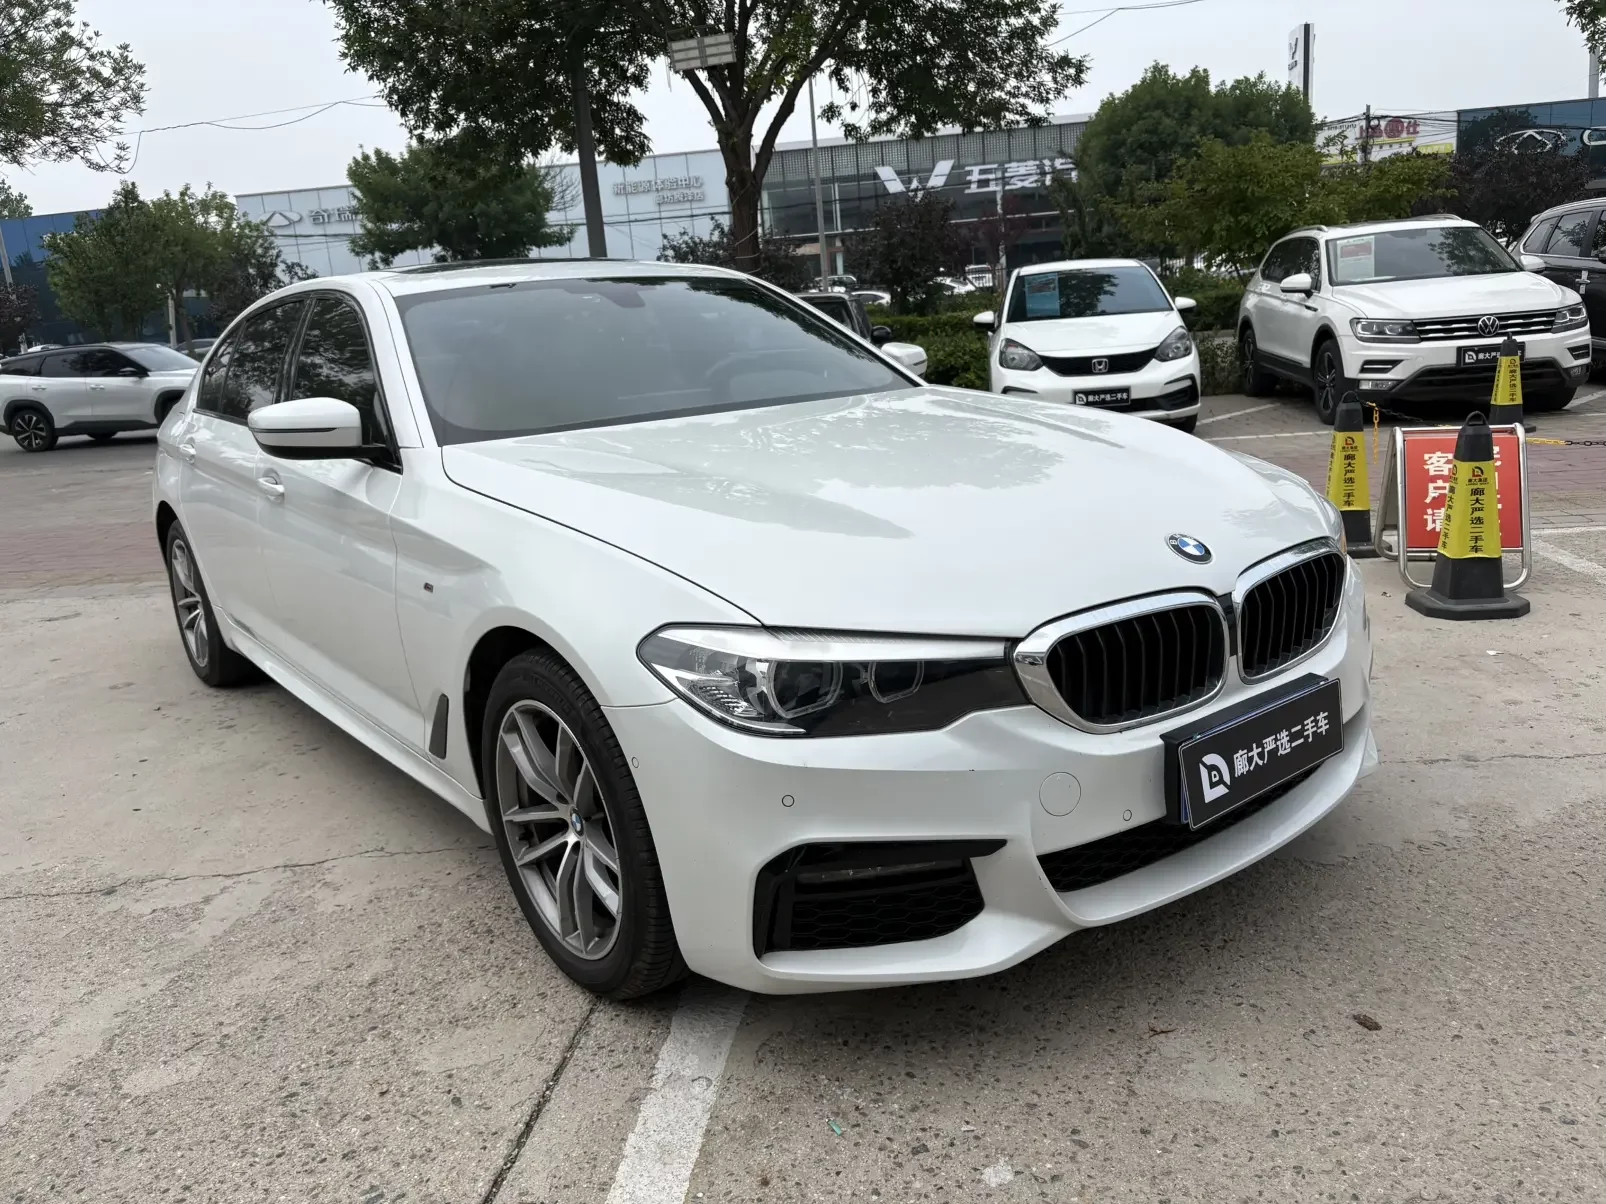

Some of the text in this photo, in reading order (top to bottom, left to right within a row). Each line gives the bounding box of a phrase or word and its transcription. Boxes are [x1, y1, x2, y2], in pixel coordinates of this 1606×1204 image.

[1343, 453, 1356, 507] 廊大严选二手车
[1469, 487, 1485, 553] 廊大严选二手车
[1233, 711, 1330, 778] 廊大严选二手车
